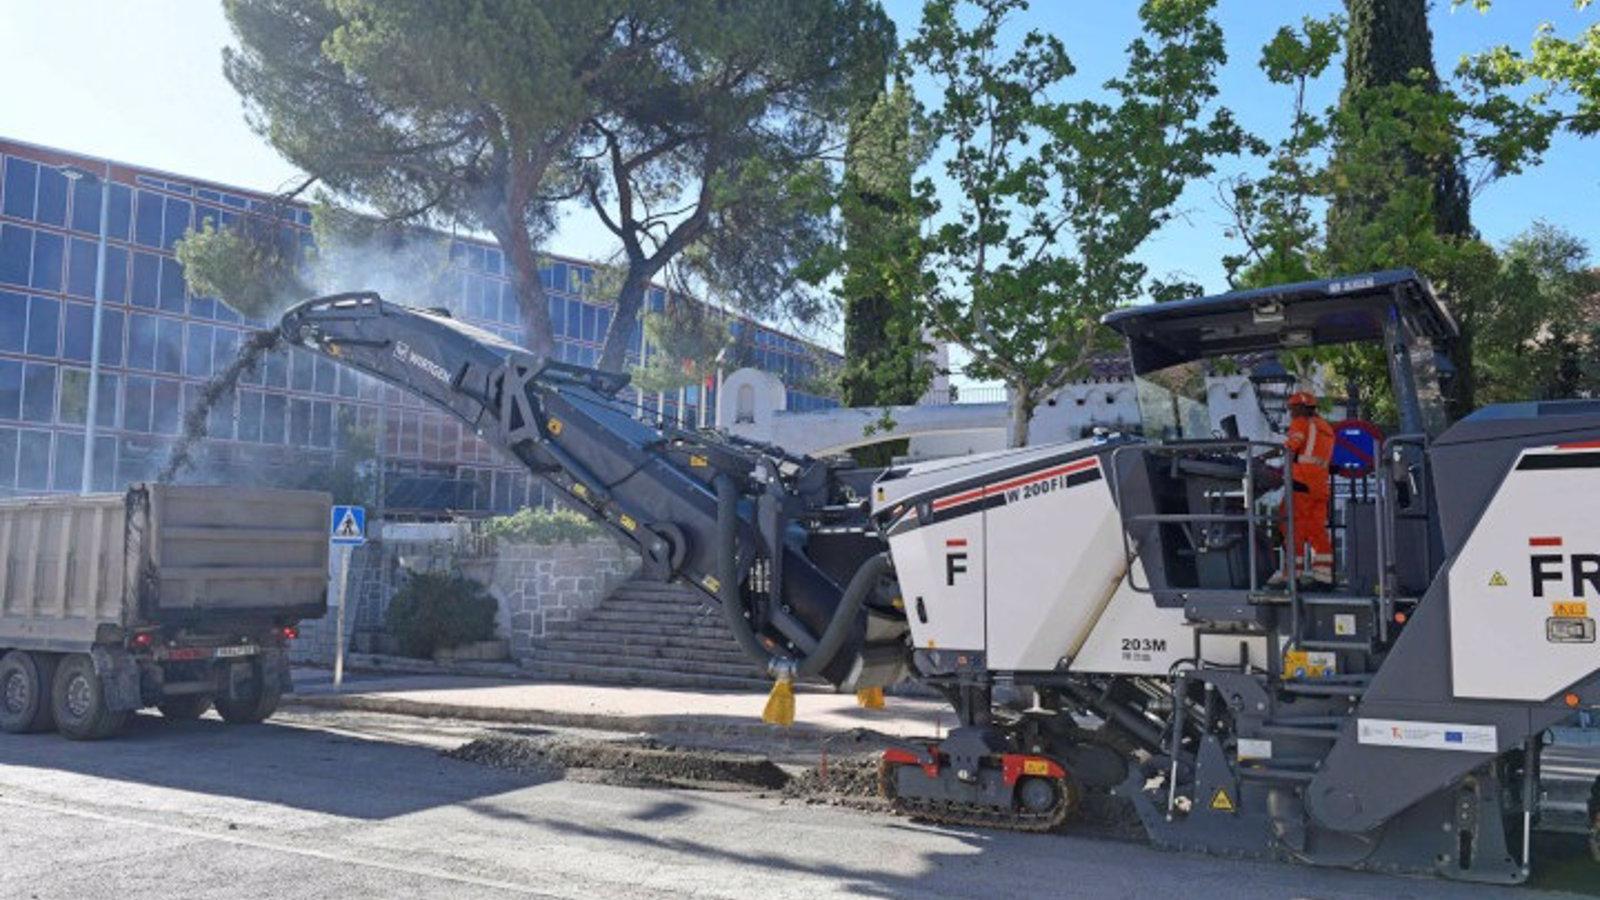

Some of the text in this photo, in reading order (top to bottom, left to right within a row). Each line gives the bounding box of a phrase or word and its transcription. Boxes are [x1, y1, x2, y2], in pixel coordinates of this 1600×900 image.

[1006, 488, 1020, 503] W
[946, 552, 968, 586] F
[1121, 638, 1167, 652] 203M
